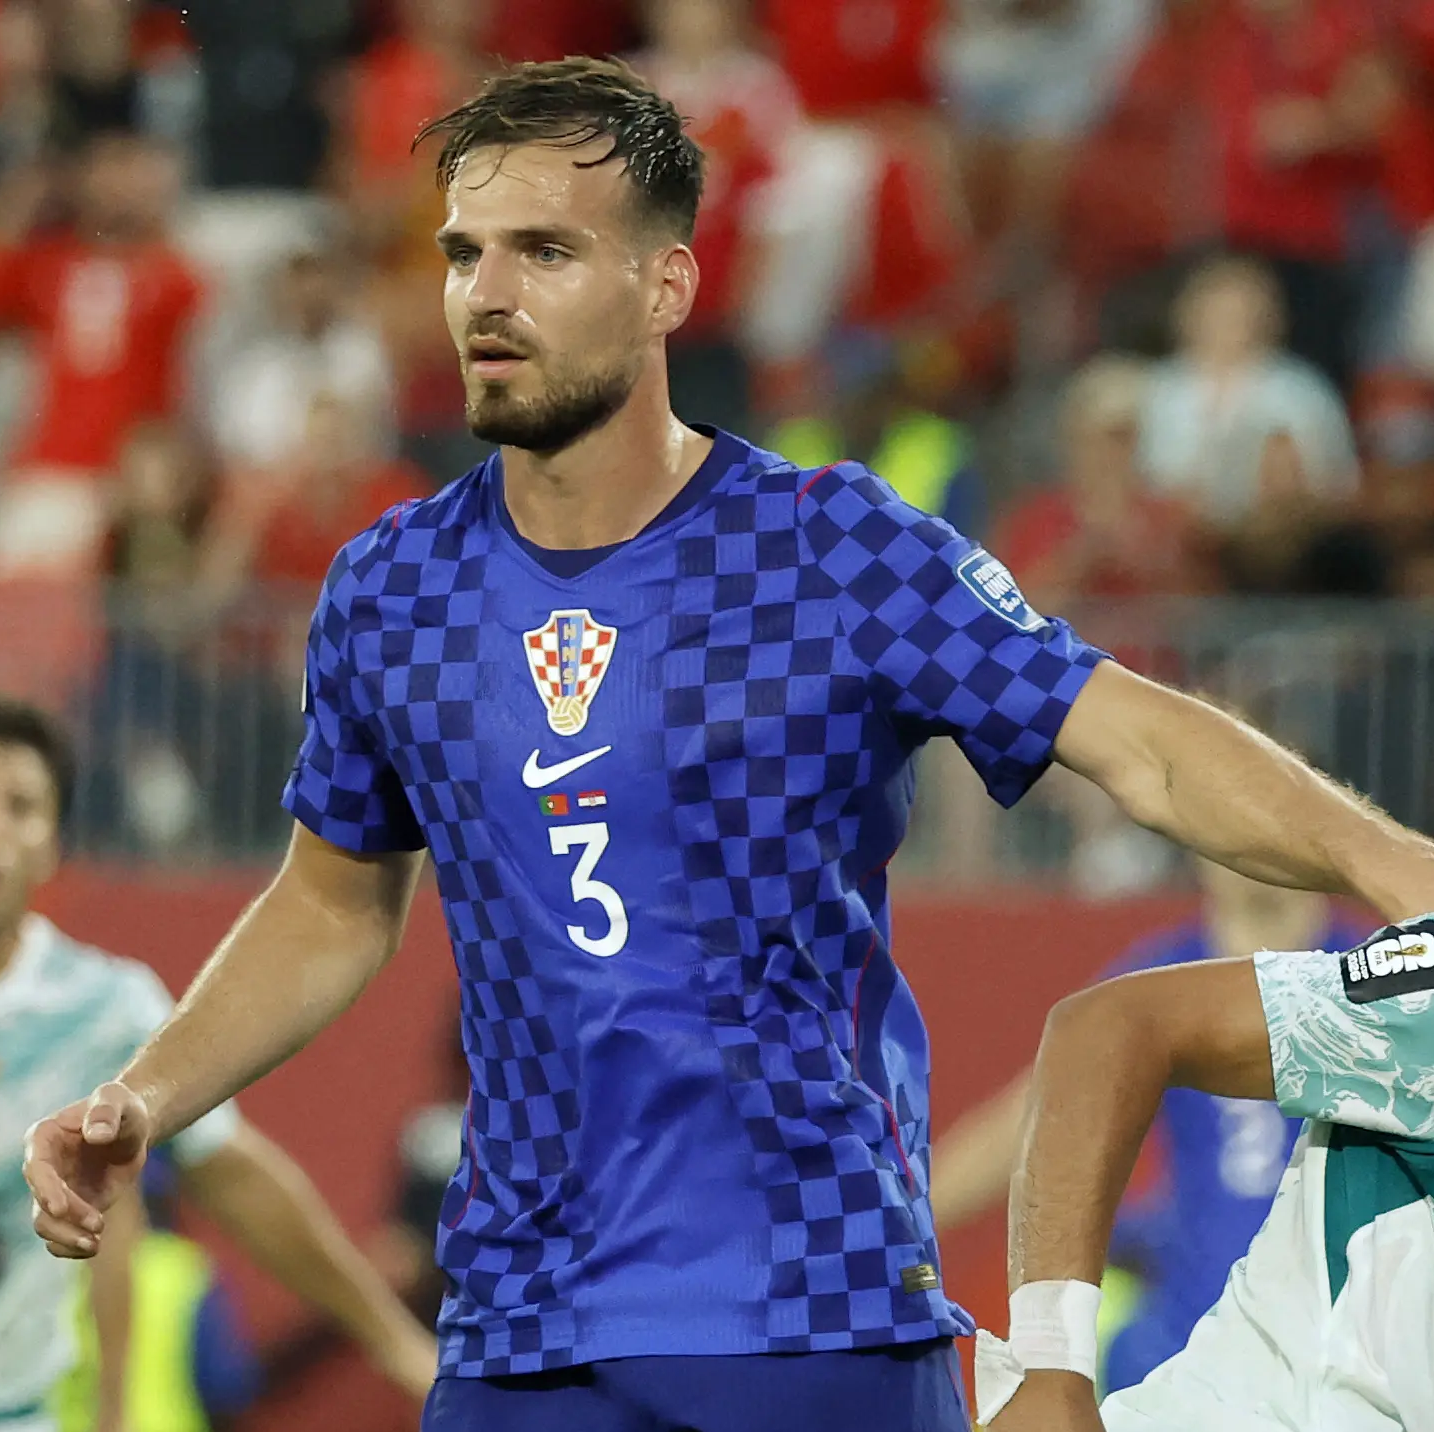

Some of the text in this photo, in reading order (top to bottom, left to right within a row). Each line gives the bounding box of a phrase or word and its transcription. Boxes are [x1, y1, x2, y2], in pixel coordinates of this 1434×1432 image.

[548, 822, 629, 957] 3
[1347, 951, 1362, 982] 2026
[1373, 950, 1384, 967] FIFA
